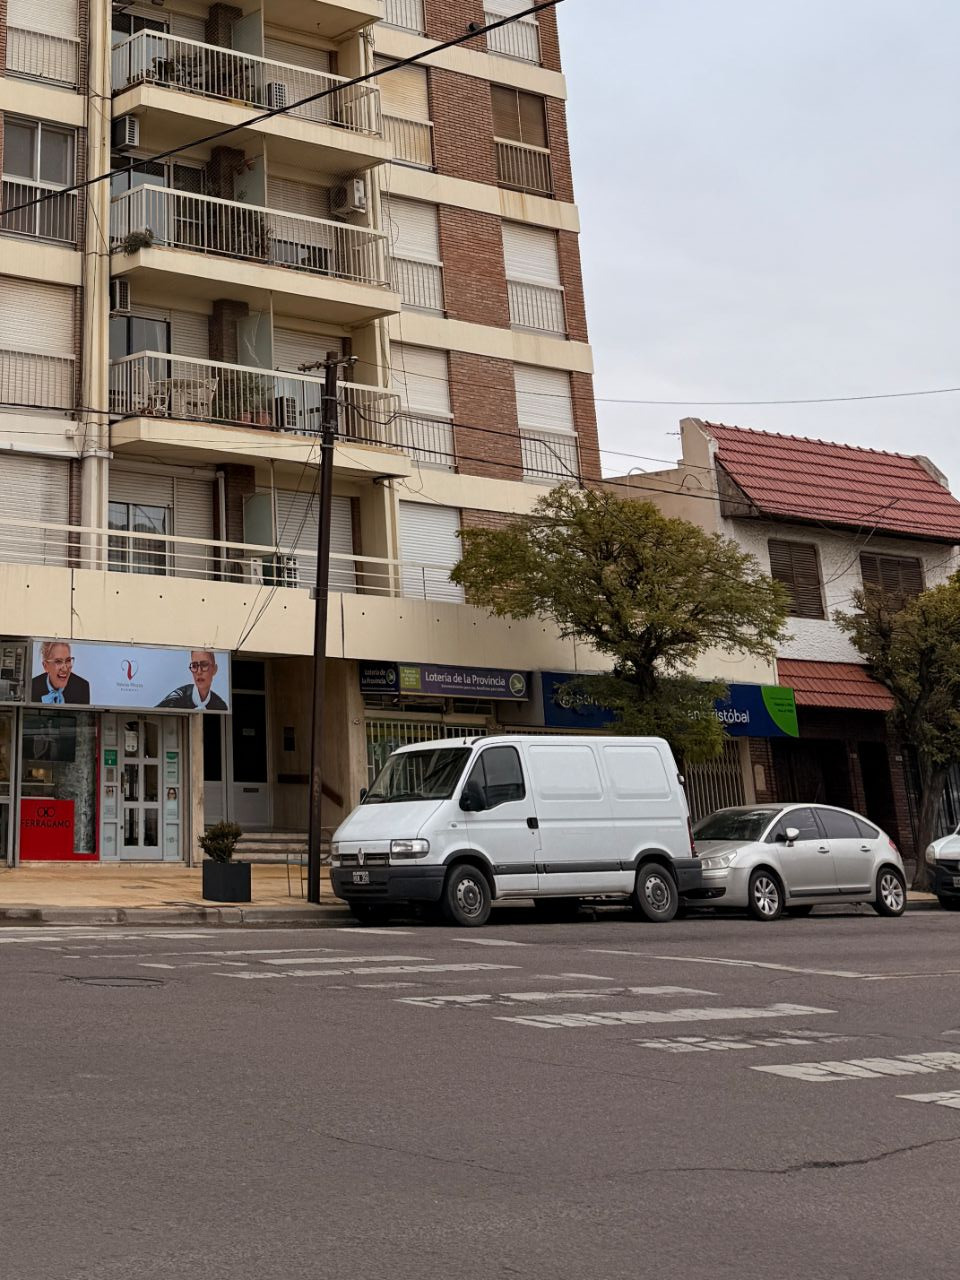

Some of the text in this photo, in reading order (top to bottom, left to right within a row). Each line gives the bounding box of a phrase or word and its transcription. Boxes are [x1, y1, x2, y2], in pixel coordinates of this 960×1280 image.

[425, 671, 452, 683] Lotería
[452, 673, 463, 683] de
[472, 674, 506, 686] Provincia
[20, 819, 70, 829] FERRAGAMO
